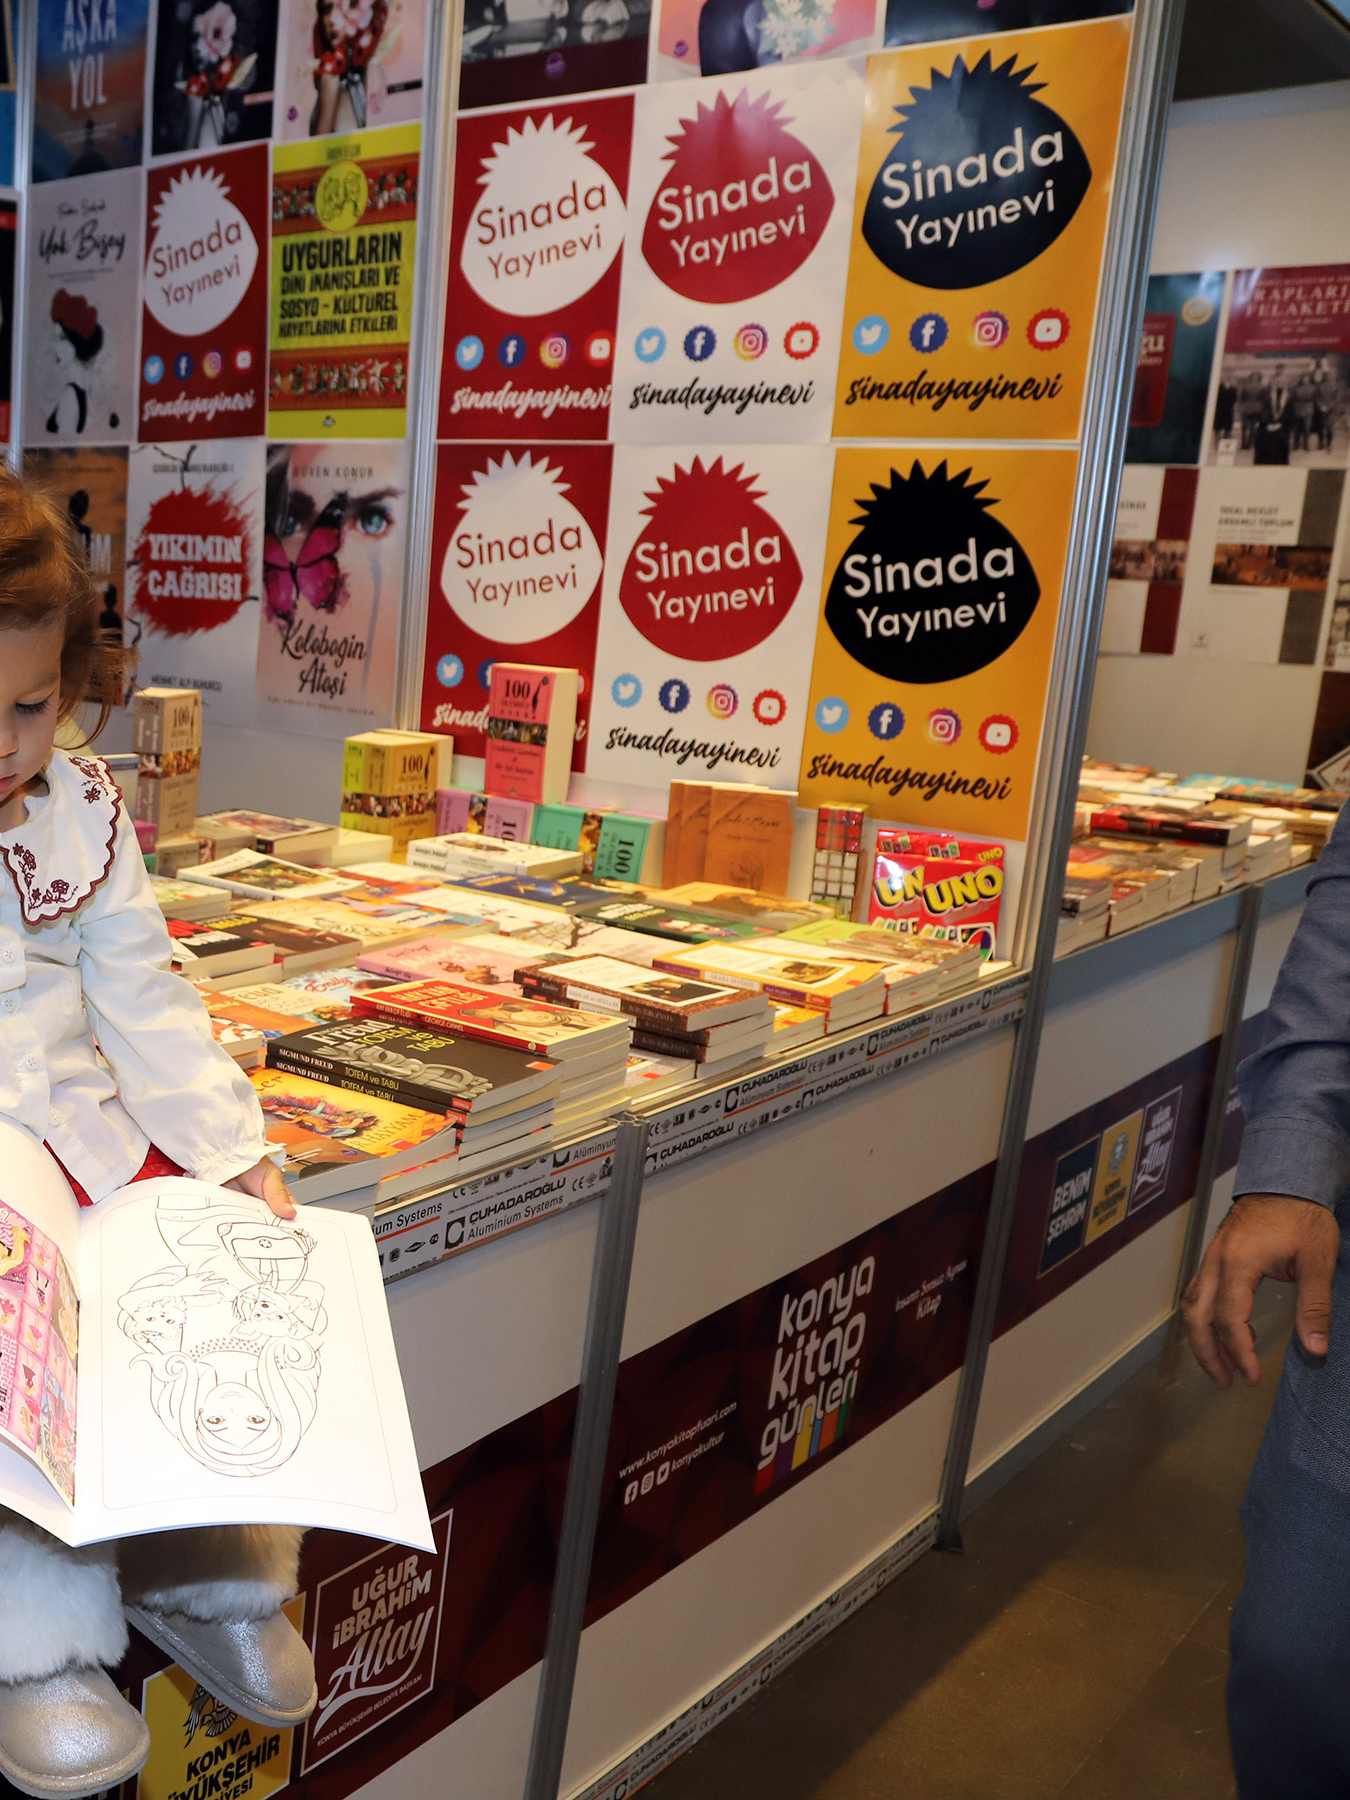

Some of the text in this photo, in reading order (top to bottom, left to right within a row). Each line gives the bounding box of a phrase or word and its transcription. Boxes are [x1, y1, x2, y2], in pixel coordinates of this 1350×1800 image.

[68, 52, 107, 111] YOL
[881, 126, 1066, 209] Sinada
[476, 180, 608, 247] Sinada
[658, 157, 813, 232] Sinada
[894, 179, 1058, 252] Yayınevi
[152, 216, 242, 280] Sinada
[282, 231, 402, 273] UYGURLARIN
[486, 224, 602, 281] Yayınevi
[668, 205, 807, 269] Yayınevi
[161, 258, 242, 308] Yayınevi
[147, 533, 243, 564] YIKIMIN
[455, 518, 583, 570] Sinada
[635, 527, 782, 583] Sinada
[844, 536, 1015, 599] Sinada
[465, 563, 578, 608] Yayınevi
[646, 576, 776, 624] Yayınevi
[856, 592, 1008, 644] Yayınevi
[503, 679, 532, 699] 100
[977, 847, 1004, 862] UNO
[923, 866, 1003, 914] UNO
[302, 1018, 395, 1047] Freud
[356, 1026, 417, 1046] TOTEM
[406, 1036, 456, 1054] TABU
[276, 1061, 306, 1077] SIGMUND
[306, 1068, 331, 1084] FREUD
[278, 1048, 310, 1064] SIGMUND
[309, 1056, 334, 1071] FREUD
[344, 1066, 369, 1082] TOTEM
[381, 1077, 400, 1091] TABU
[741, 1058, 808, 1096] ÇUHADAROĞLU
[659, 1120, 736, 1160] ÇUHADAROĞLU
[396, 1201, 443, 1227] Systems
[467, 1193, 564, 1242] Aluminium Systems
[468, 1176, 567, 1227] ÇUHADAROĞLU
[778, 1255, 877, 1345] konya
[767, 1310, 867, 1410] kitap
[757, 1358, 861, 1471] günleri
[671, 1431, 726, 1472] konyakultur
[352, 1555, 419, 1612] UĞUR
[315, 1606, 435, 1728] Altay
[186, 1729, 251, 1783] KONYA
[317, 1729, 339, 1747] KONYA
